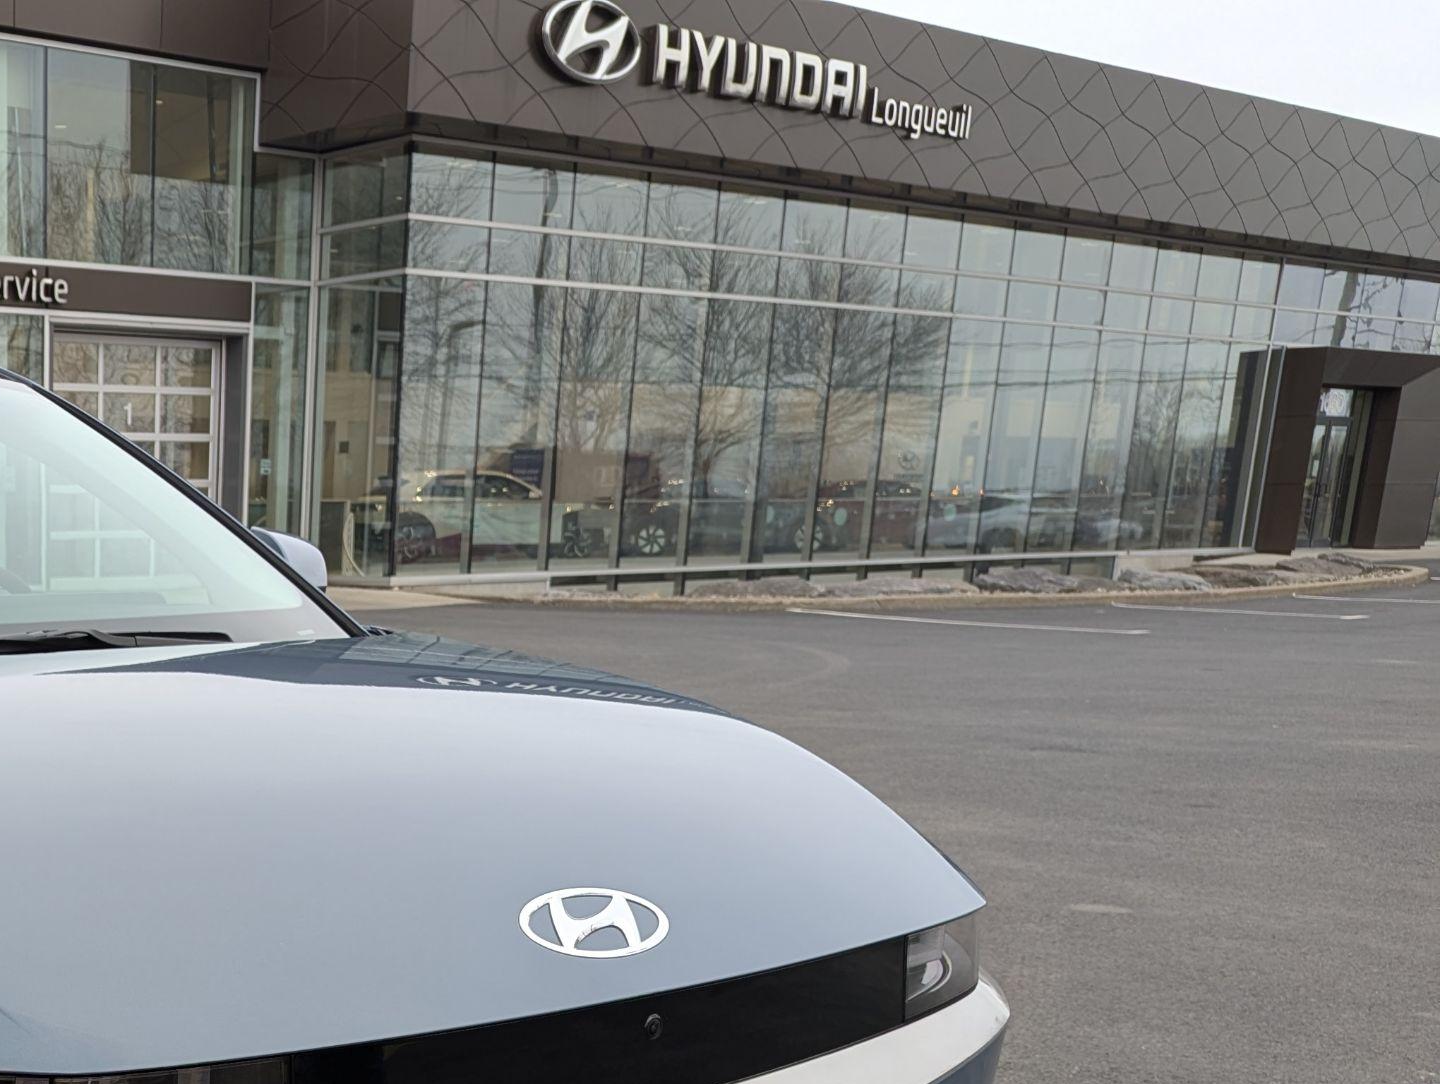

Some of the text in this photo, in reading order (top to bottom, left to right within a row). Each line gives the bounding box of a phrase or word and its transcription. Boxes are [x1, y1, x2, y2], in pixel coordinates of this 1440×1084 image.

[653, 24, 972, 140] HYUNDAI Longueuil
[123, 402, 132, 426] 1
